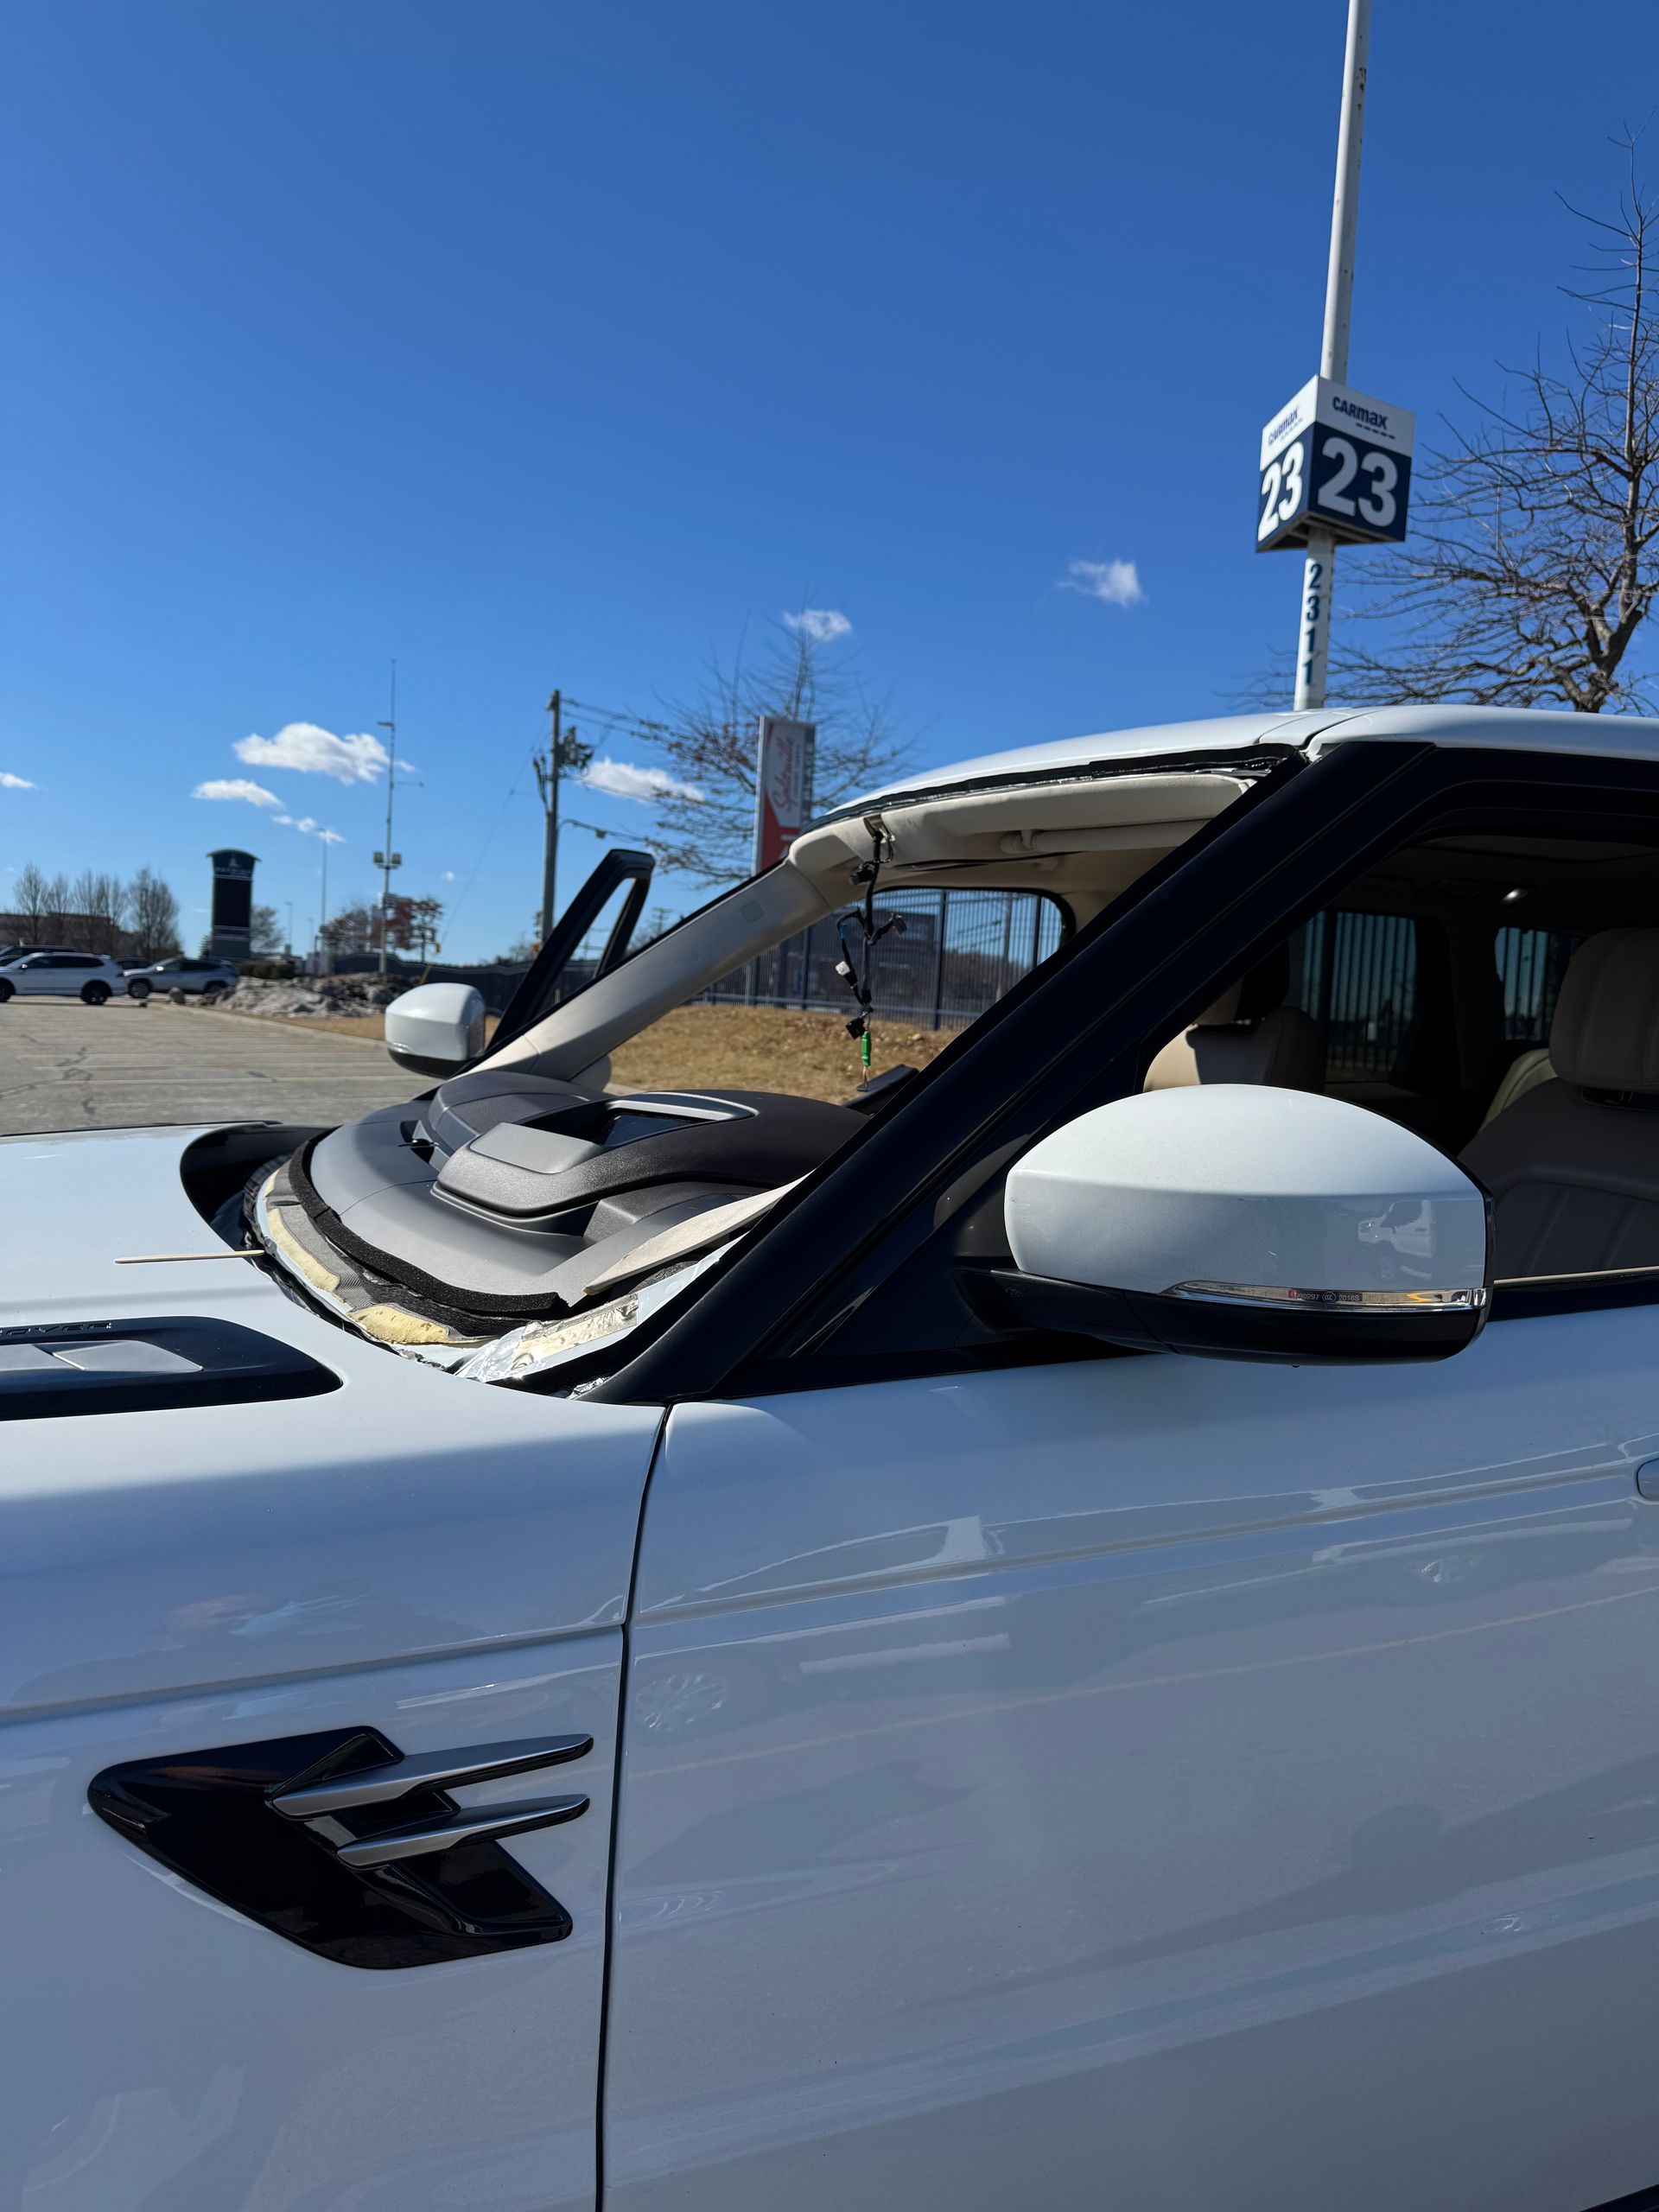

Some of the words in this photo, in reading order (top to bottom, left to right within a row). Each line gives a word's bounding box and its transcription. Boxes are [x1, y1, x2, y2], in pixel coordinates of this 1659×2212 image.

[1257, 441, 1305, 543] 23
[1317, 436, 1398, 527] 23
[1303, 563, 1324, 686] 2311
